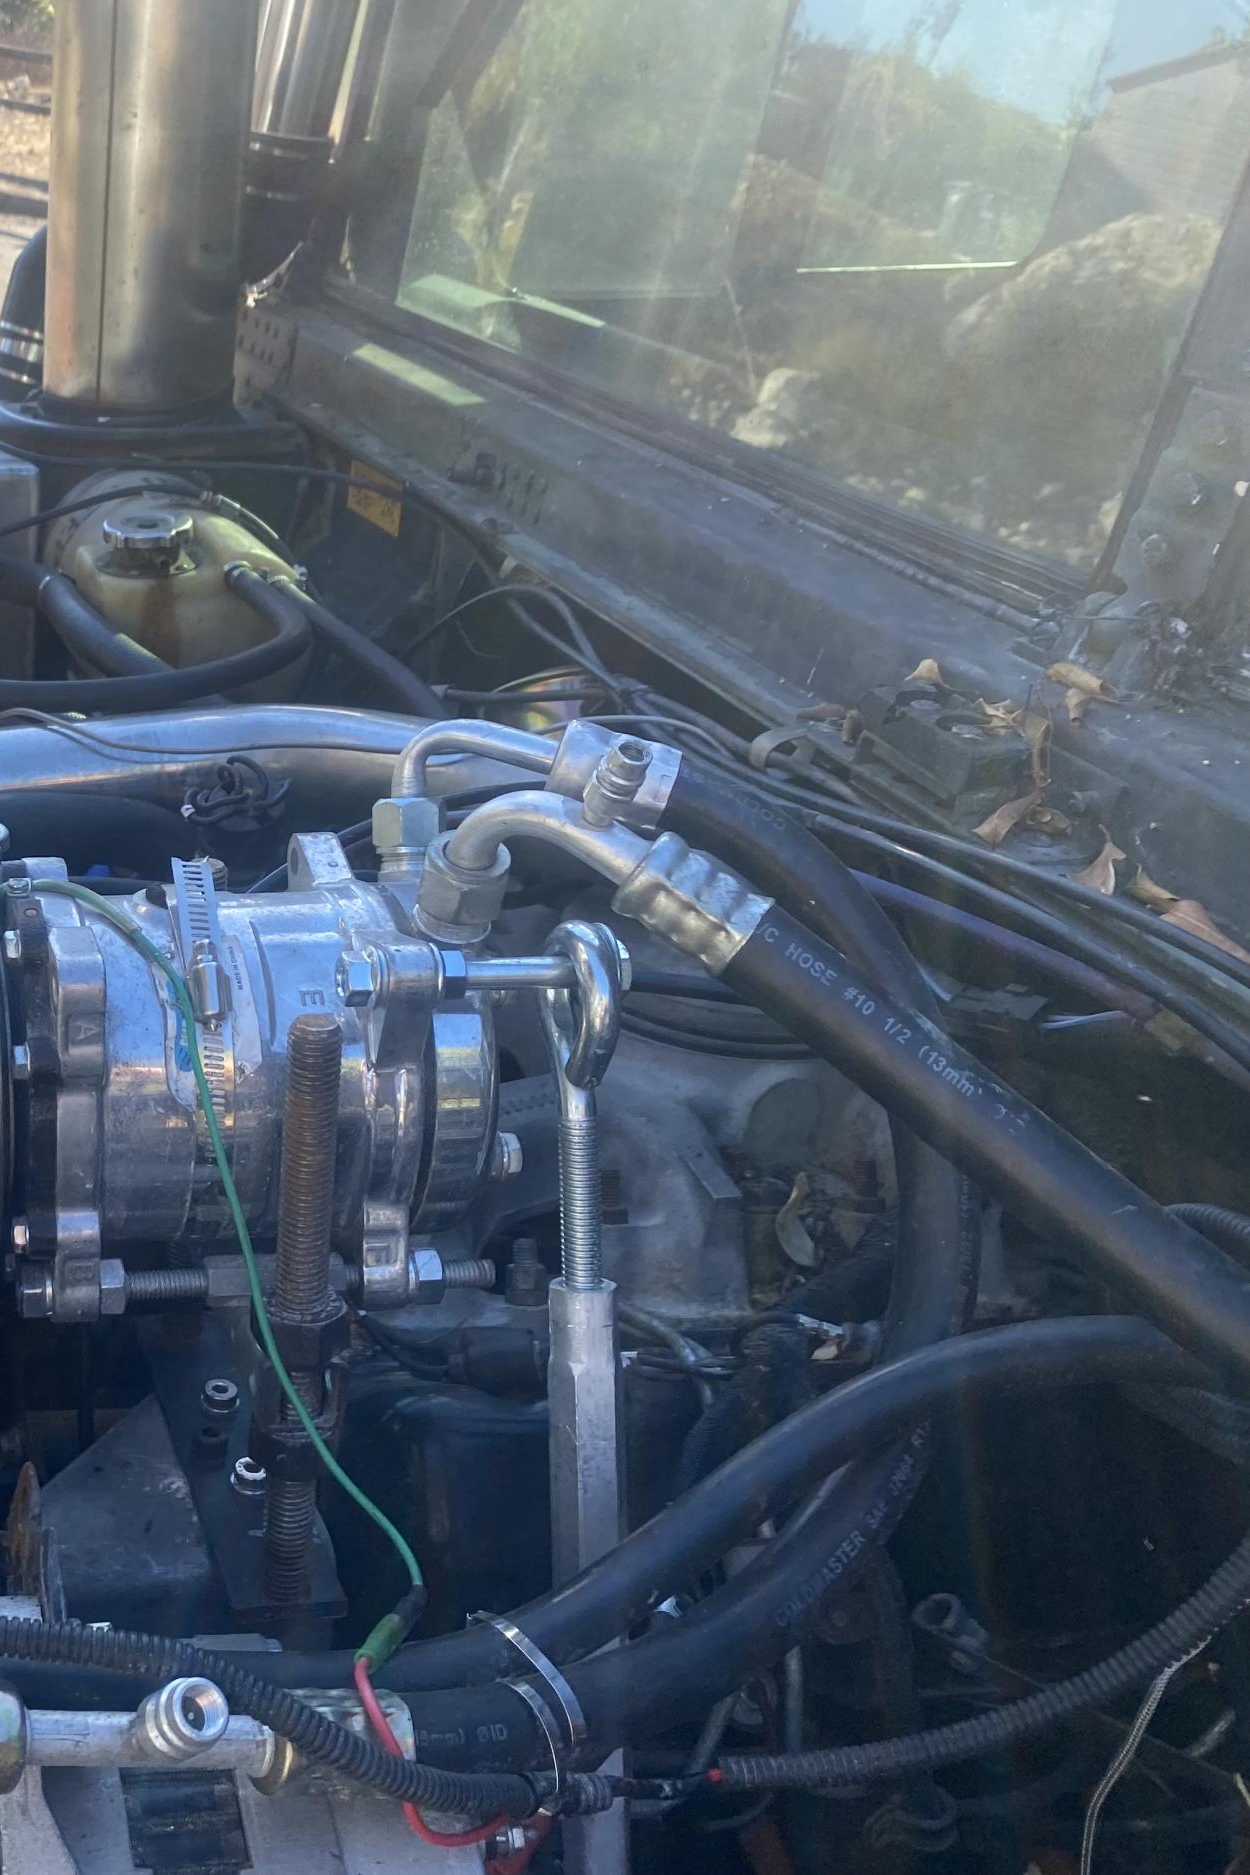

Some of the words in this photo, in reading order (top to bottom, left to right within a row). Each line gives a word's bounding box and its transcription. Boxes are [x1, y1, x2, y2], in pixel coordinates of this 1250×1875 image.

[784, 942, 838, 986] HOSE
[844, 986, 875, 1015] #10
[884, 1017, 912, 1044] 1/2
